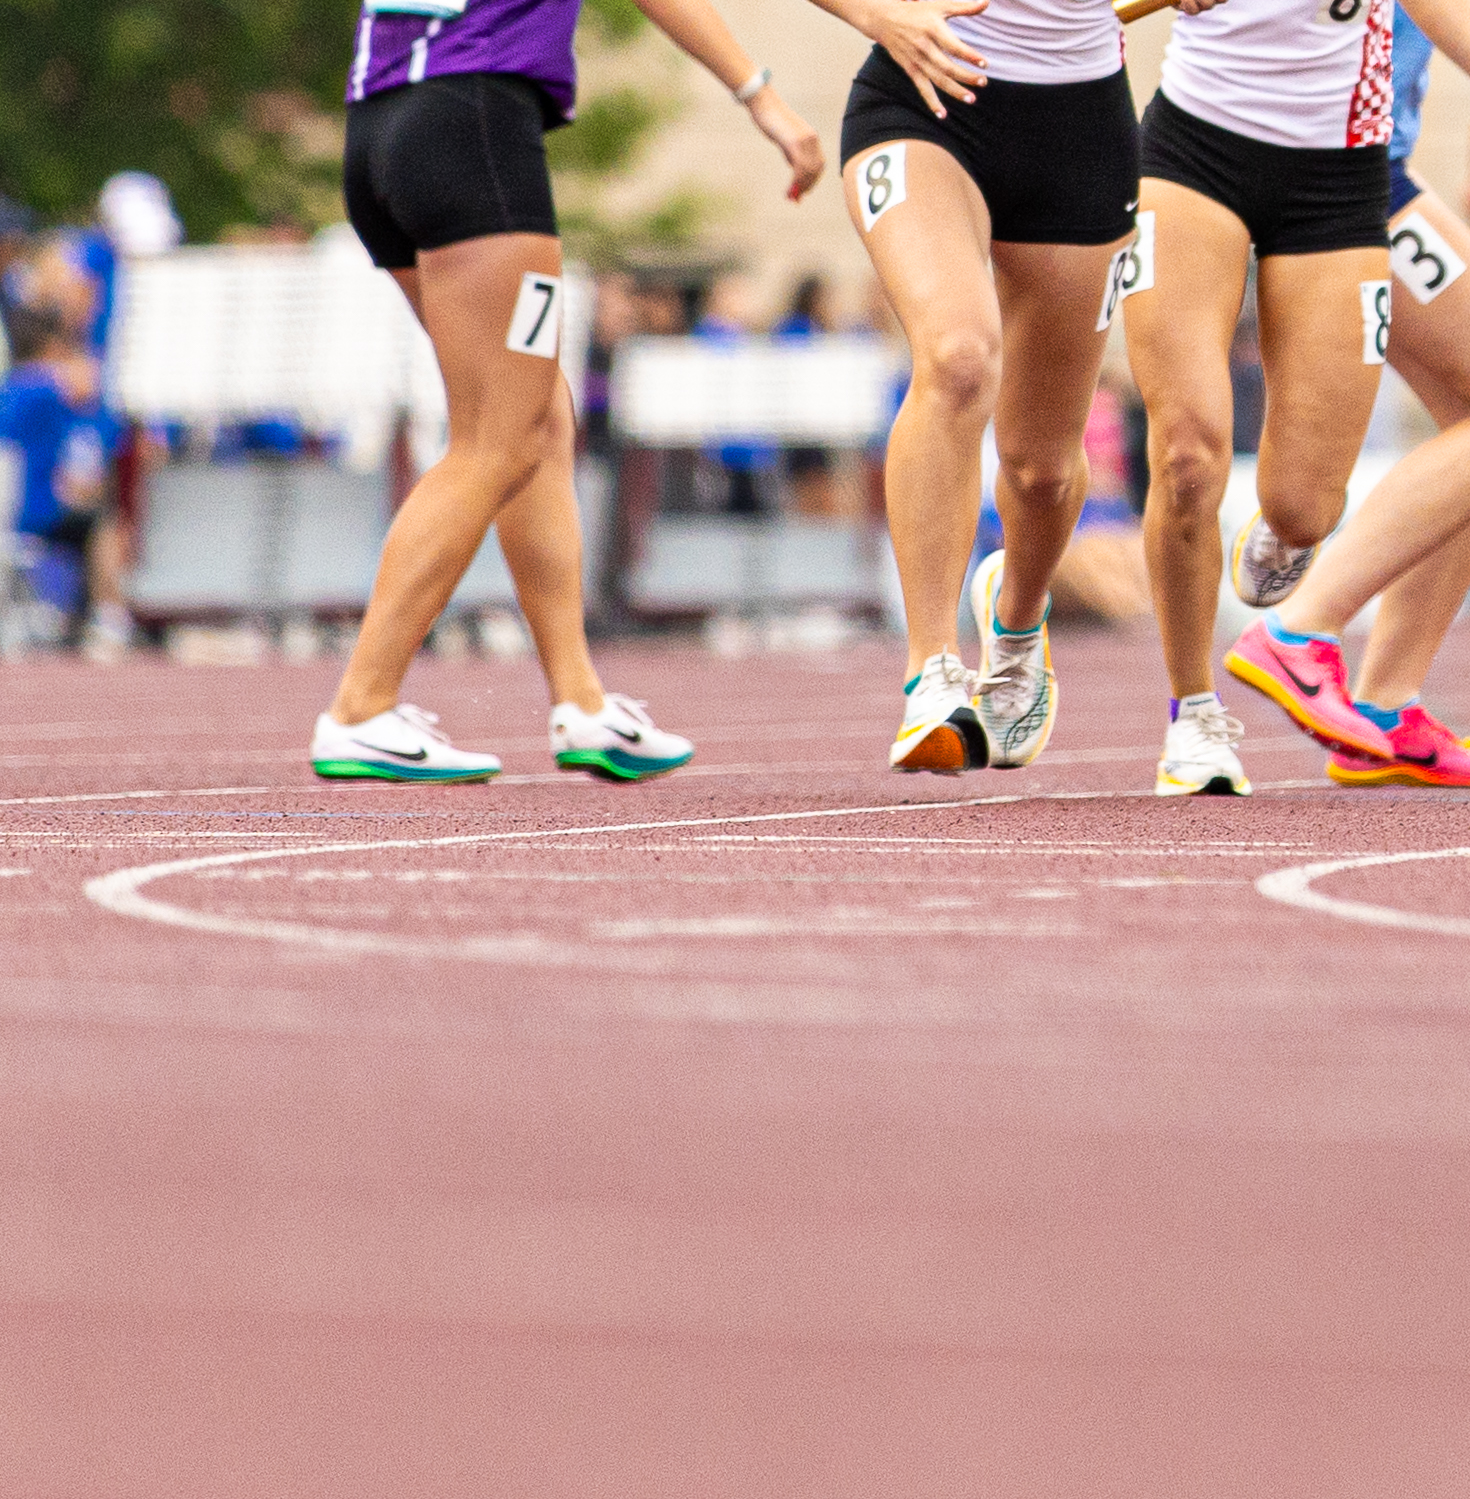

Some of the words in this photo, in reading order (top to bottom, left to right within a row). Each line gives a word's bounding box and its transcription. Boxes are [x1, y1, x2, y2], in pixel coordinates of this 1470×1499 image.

[866, 154, 893, 215] 8
[1106, 251, 1128, 321] 8
[1390, 228, 1448, 291] 3
[525, 281, 556, 347] 7
[1374, 286, 1390, 358] 8
